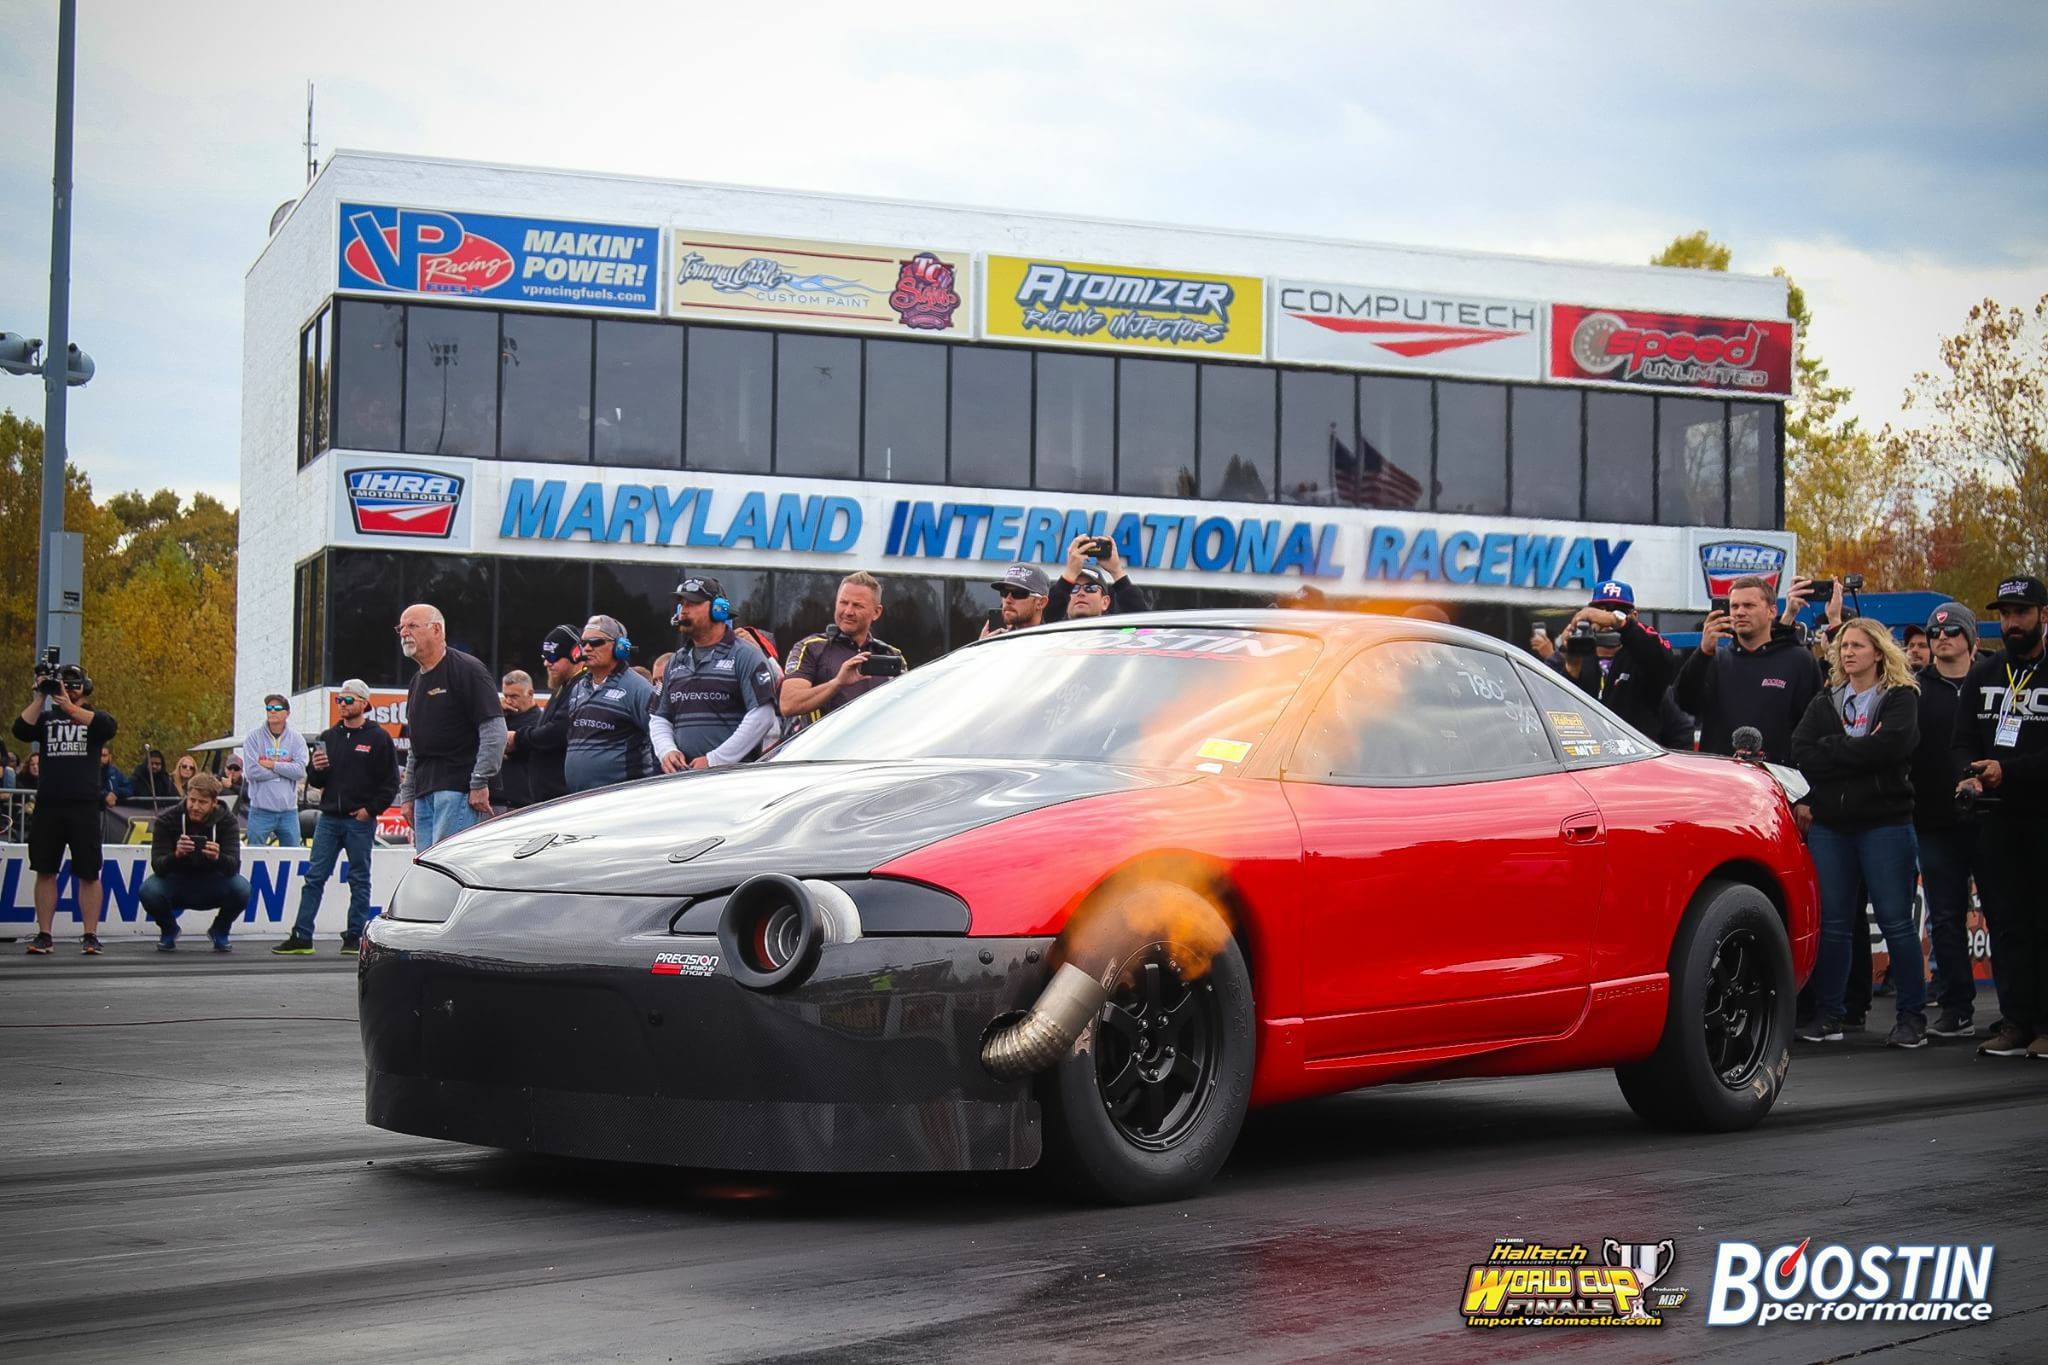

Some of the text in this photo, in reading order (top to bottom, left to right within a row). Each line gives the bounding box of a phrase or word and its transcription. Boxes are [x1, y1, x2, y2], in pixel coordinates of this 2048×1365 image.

[349, 208, 464, 292] VP
[522, 228, 645, 260] MAKIN'
[425, 255, 512, 281] Racing
[522, 256, 649, 287] POWER!
[426, 282, 483, 297] FUELS
[522, 284, 648, 303] vpracingfuels.com
[756, 291, 870, 309] CUSTOM PAINT
[1016, 264, 1234, 322] ATOMIZER
[1280, 288, 1536, 330] COMPUTECH
[1022, 307, 1230, 343] RACING INJECTORS
[1641, 361, 1768, 388] UNLIMITED
[358, 473, 453, 494] IHRA
[355, 490, 453, 502] MOTORSPORTS
[499, 477, 1633, 589] MARYLAND INTERNATIONAL RACEWAY
[1707, 546, 1778, 564] IHRA
[47, 725, 88, 742] LIVE
[47, 741, 87, 752] TV CREW
[655, 952, 720, 967] PRECISION
[680, 969, 713, 977] ENGINE
